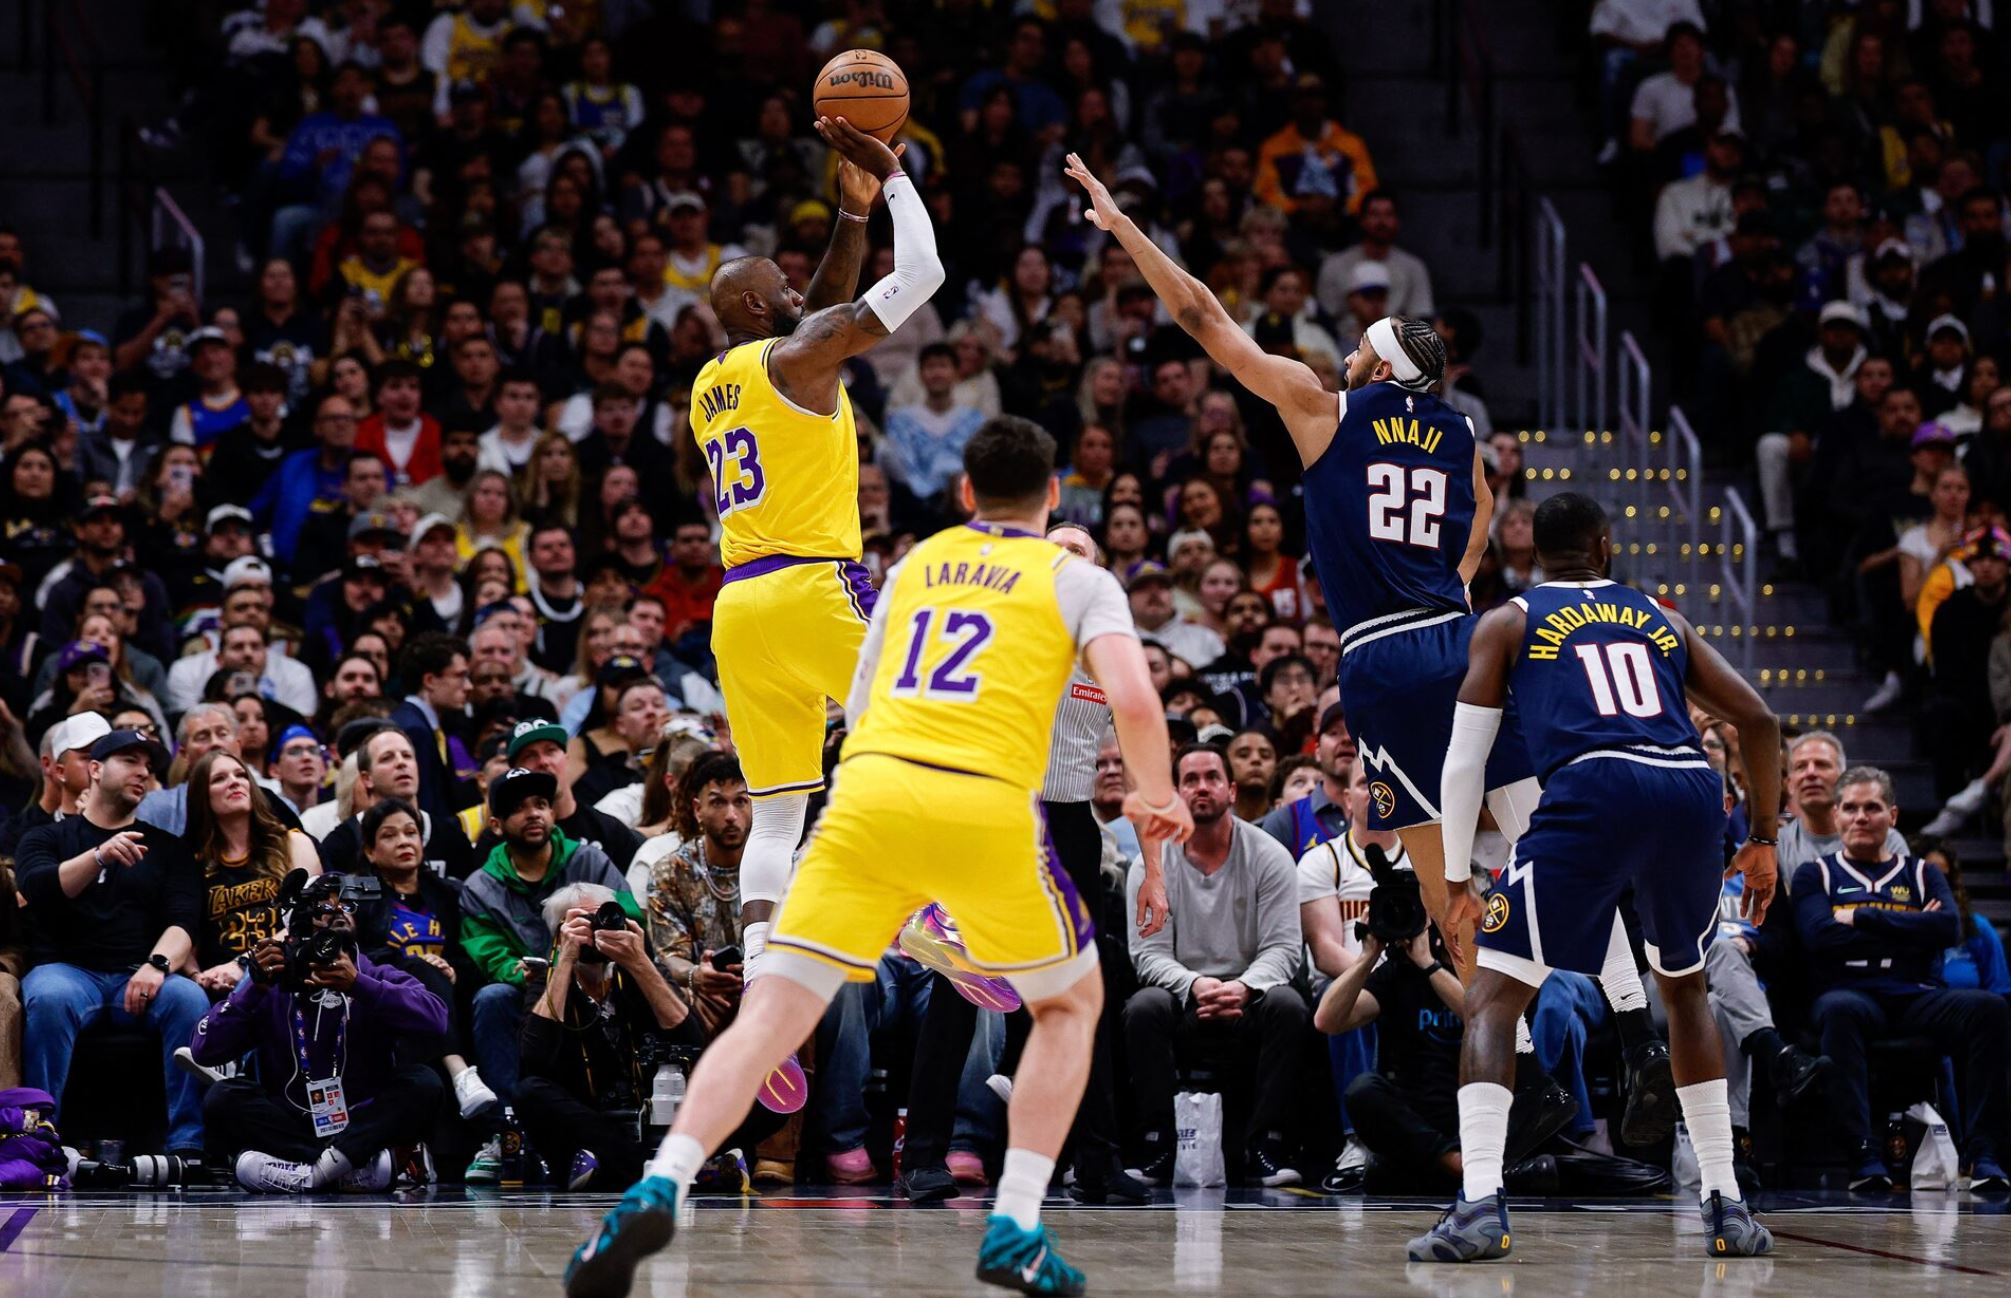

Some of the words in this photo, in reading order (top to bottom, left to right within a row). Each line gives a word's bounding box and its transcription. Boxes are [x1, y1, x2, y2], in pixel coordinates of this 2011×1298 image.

[829, 71, 894, 90] Wilson
[699, 383, 741, 422] JAMES
[1372, 416, 1444, 454] NNAJI
[704, 426, 767, 518] 23
[1367, 462, 1447, 548] 22
[926, 561, 1022, 595] LARAVIA
[1528, 602, 1652, 661] HARDAWAY
[1647, 625, 1679, 658] JR.
[894, 608, 993, 697] 12
[1072, 686, 1107, 702] Emirate
[1574, 641, 1663, 719] 10
[207, 878, 281, 917] LAKER
